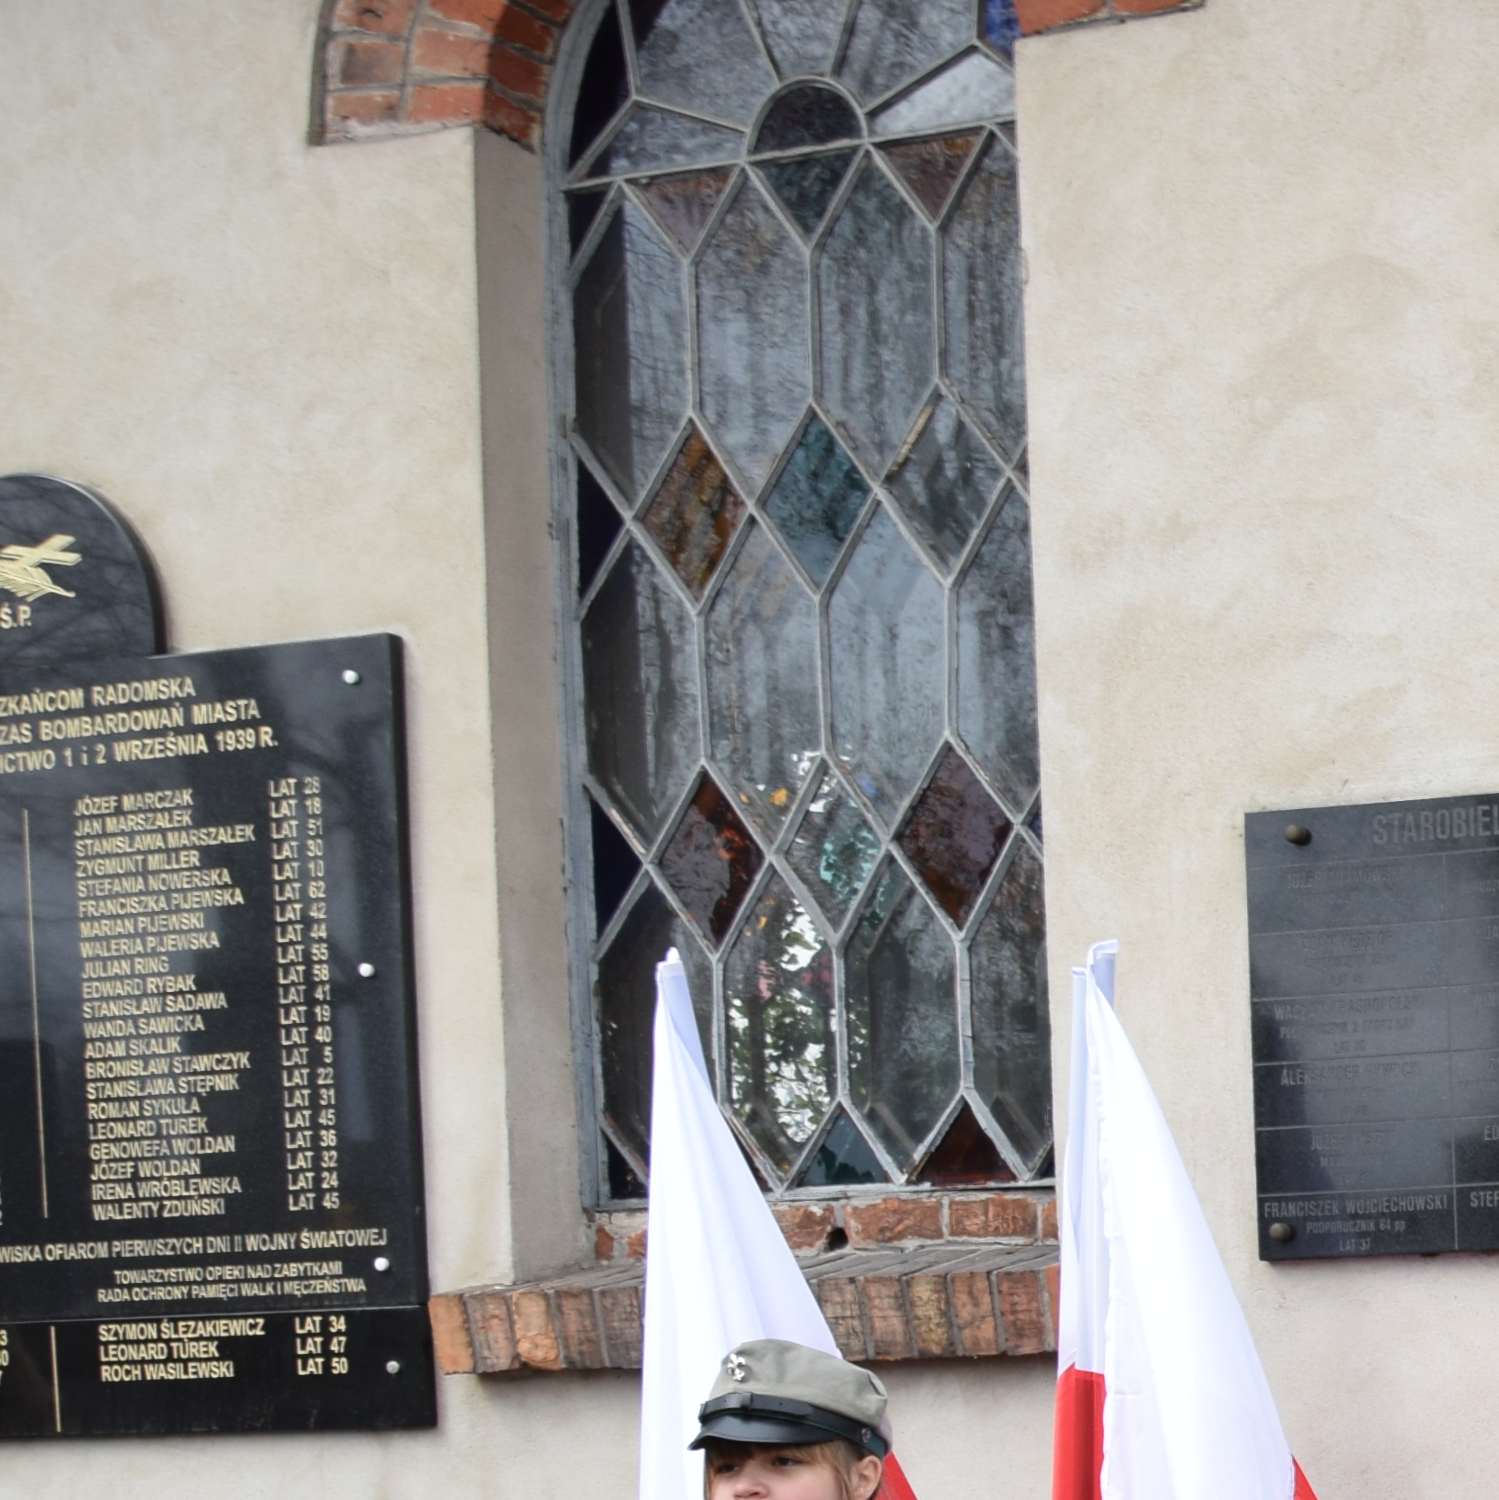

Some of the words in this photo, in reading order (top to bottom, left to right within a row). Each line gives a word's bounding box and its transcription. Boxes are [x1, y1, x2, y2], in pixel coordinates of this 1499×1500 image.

[91, 677, 196, 707] RADOMSKA
[39, 702, 184, 742] BOMBARDOWAŃ
[192, 699, 260, 725] MIASTA
[64, 748, 73, 767] 1
[81, 746, 88, 766] i
[97, 744, 107, 764] 2
[113, 732, 209, 762] WRZEŚNIA
[216, 729, 256, 752] 1939
[258, 726, 278, 748] R.
[76, 833, 166, 857] STANISŁAWA
[167, 825, 256, 848] MARSZAŁEK
[270, 820, 299, 839] LAT
[307, 819, 323, 836] 51
[76, 855, 145, 877] ZYGMUNT
[148, 850, 200, 871] MILLER
[272, 841, 299, 860] LAT
[306, 839, 323, 857] 30
[83, 979, 144, 999] EDWARD
[147, 974, 197, 993] RYBAK
[278, 966, 305, 984] LAT
[312, 965, 330, 982] 58
[85, 1058, 170, 1080] BRONISŁAW
[172, 1052, 252, 1074] STAWCZYK
[282, 1048, 309, 1066] LAT
[324, 1047, 333, 1064] 5
[45, 1241, 109, 1261] OFIAROM
[112, 1233, 203, 1258] PIERWSZYCH
[206, 1235, 232, 1254] DNI
[233, 1234, 244, 1253] II
[245, 1232, 297, 1251] WOJNY
[300, 1228, 387, 1249] ŚWIATOWEJ
[114, 1266, 204, 1285] TOWARZYSTWO
[205, 1265, 245, 1281] OPIEKI
[247, 1264, 272, 1279] NAD
[274, 1261, 343, 1278] ZABYTKAMI
[98, 1287, 130, 1304] RADA
[132, 1285, 189, 1301] OCHRONY
[191, 1283, 239, 1301] PAMIĘCI
[240, 1281, 276, 1297] WALK
[284, 1277, 366, 1298] MĘCZEŃSTWA
[98, 1323, 158, 1342] SZYMON
[295, 1316, 322, 1334] LAT
[330, 1315, 346, 1333] 34
[100, 1343, 168, 1362] LEONARD
[170, 1341, 219, 1360] TUREK
[296, 1338, 323, 1355] LAT
[330, 1336, 347, 1353] 47
[101, 1365, 143, 1382] ROCH
[144, 1361, 235, 1381] WASILEWSKI
[297, 1358, 324, 1375] LAT
[331, 1358, 348, 1375] 50
